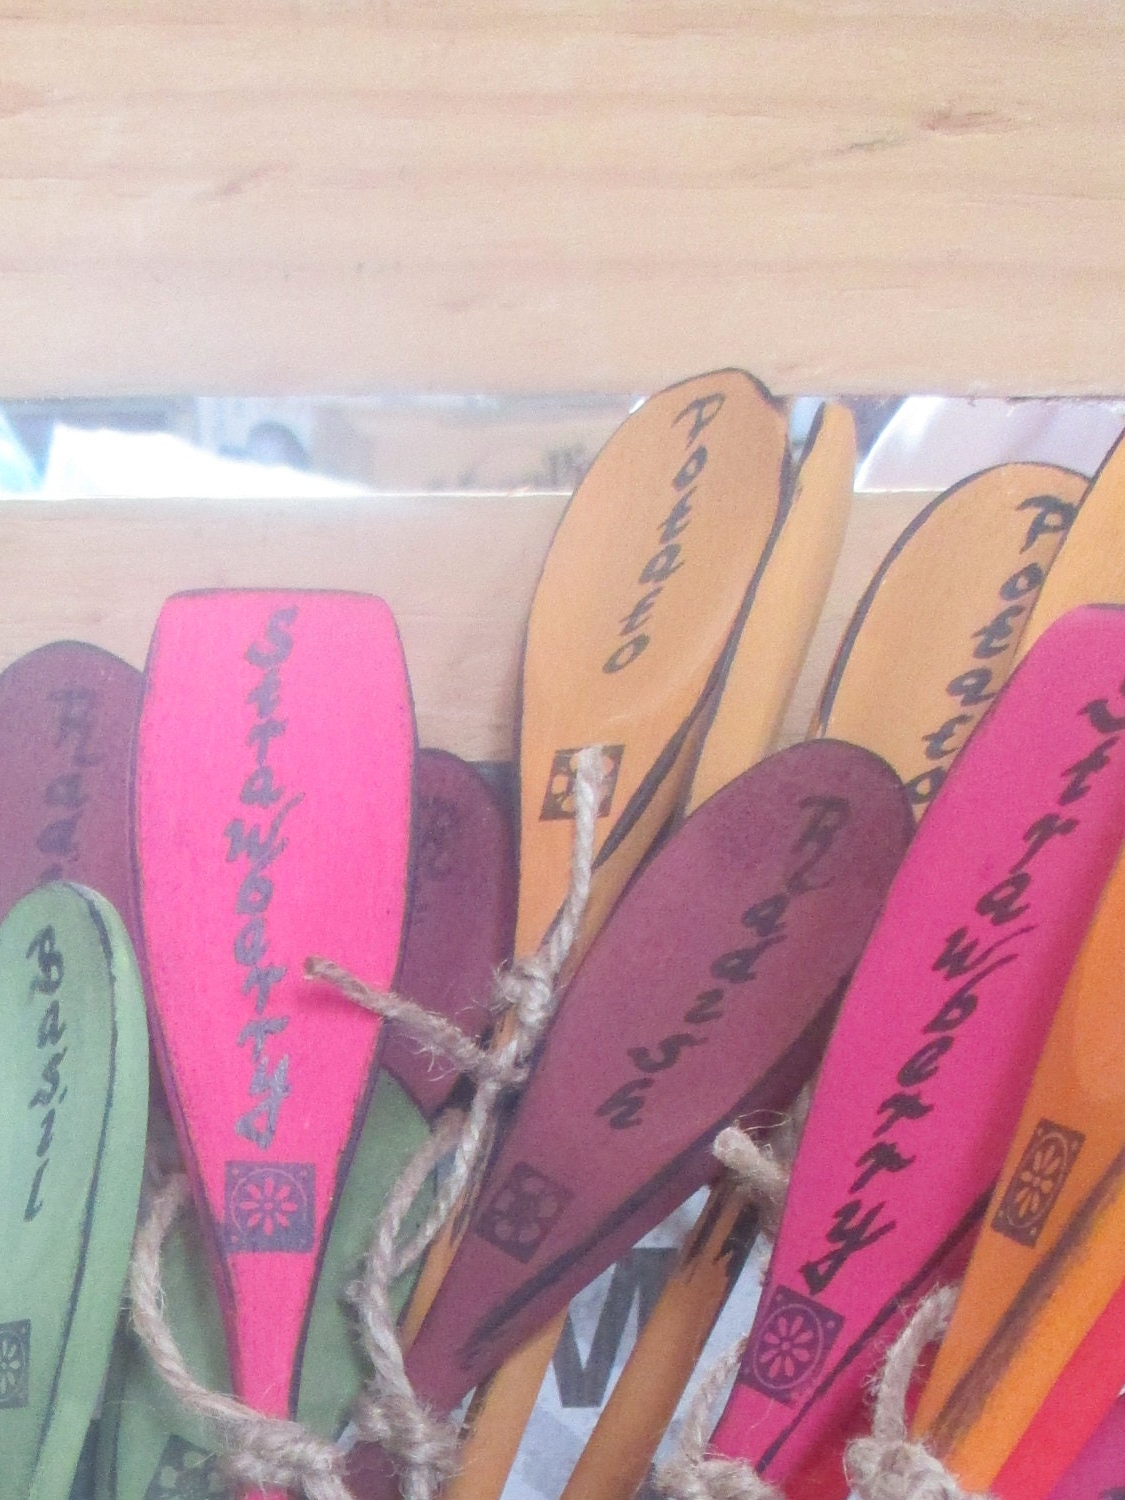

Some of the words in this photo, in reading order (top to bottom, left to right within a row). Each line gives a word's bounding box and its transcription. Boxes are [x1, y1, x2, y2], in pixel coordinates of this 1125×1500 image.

[601, 392, 726, 674] Potato
[904, 493, 1078, 805] Potato
[223, 603, 304, 1149] Strawberry
[597, 796, 851, 1130] Radish
[24, 924, 68, 1222] Basil
